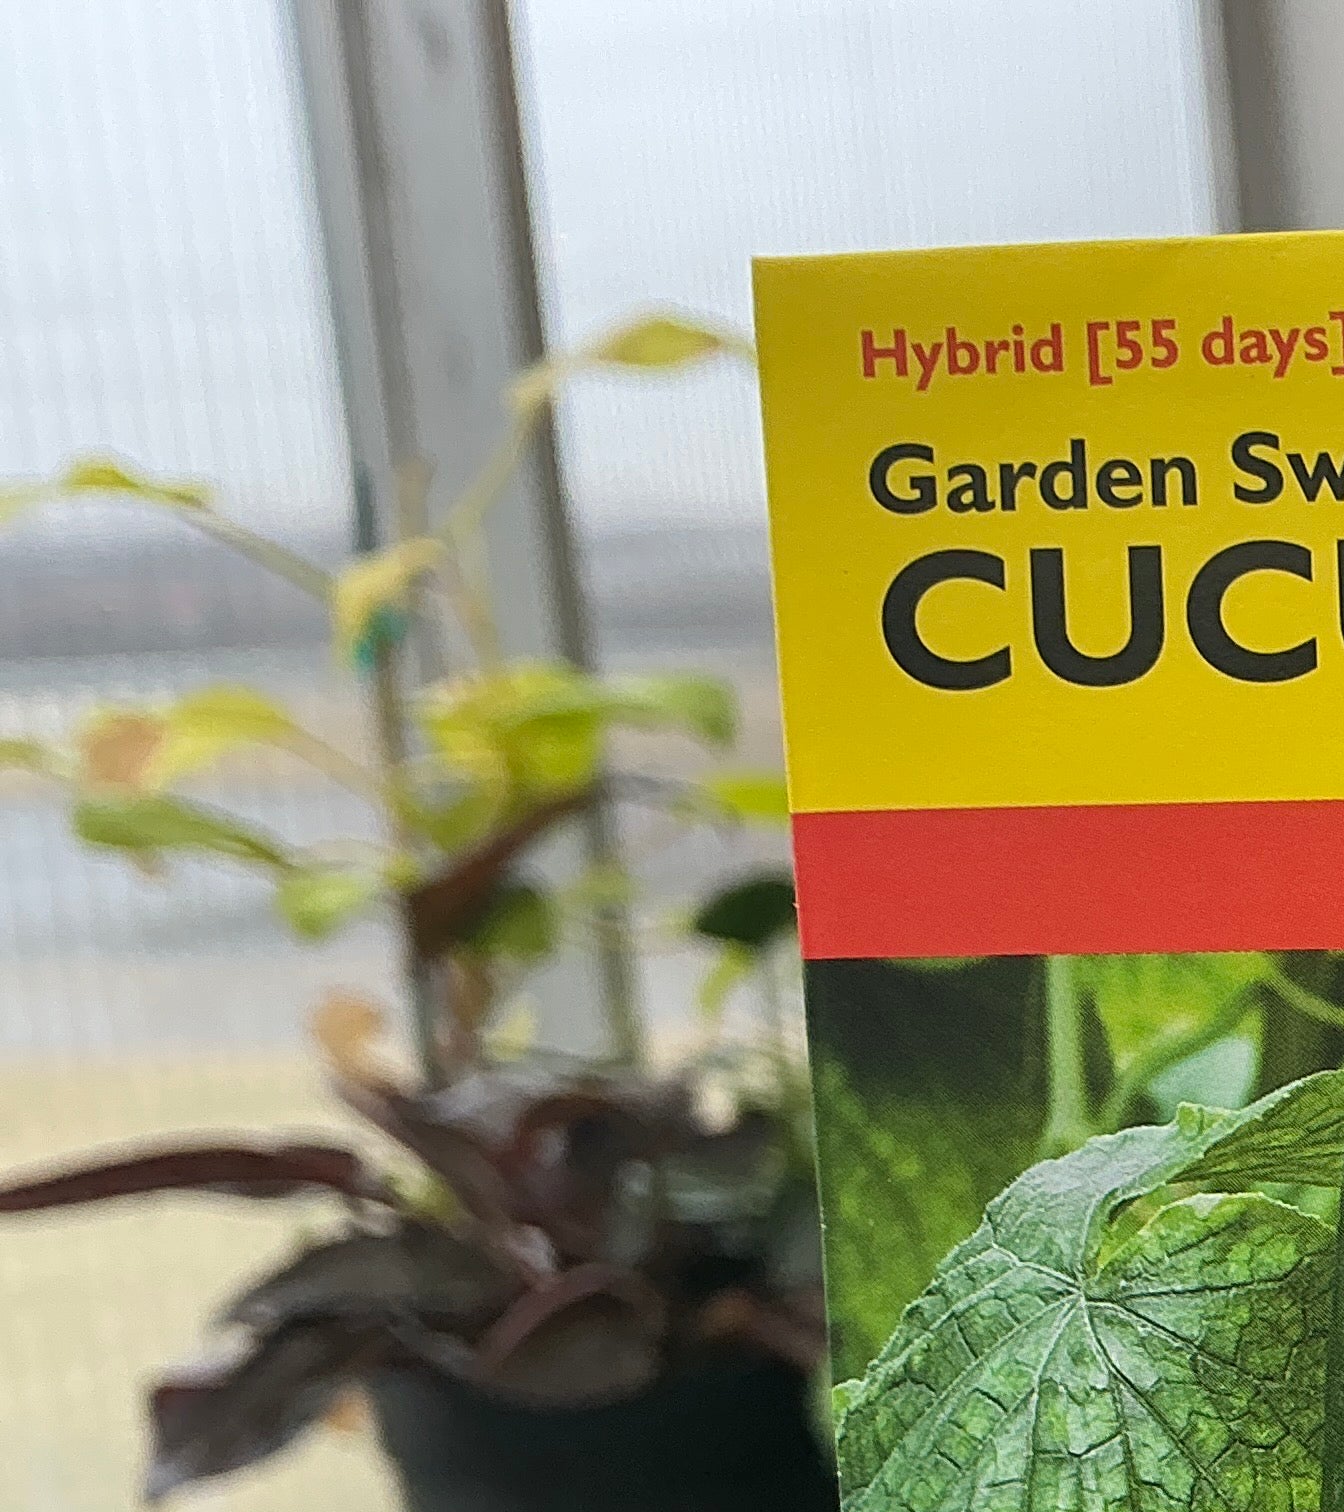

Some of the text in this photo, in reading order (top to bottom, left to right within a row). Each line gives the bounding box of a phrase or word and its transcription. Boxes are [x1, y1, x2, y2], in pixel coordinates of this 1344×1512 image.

[860, 322, 1066, 392] Hybrid
[1086, 318, 1180, 386] [55
[869, 437, 1198, 516] Garden
